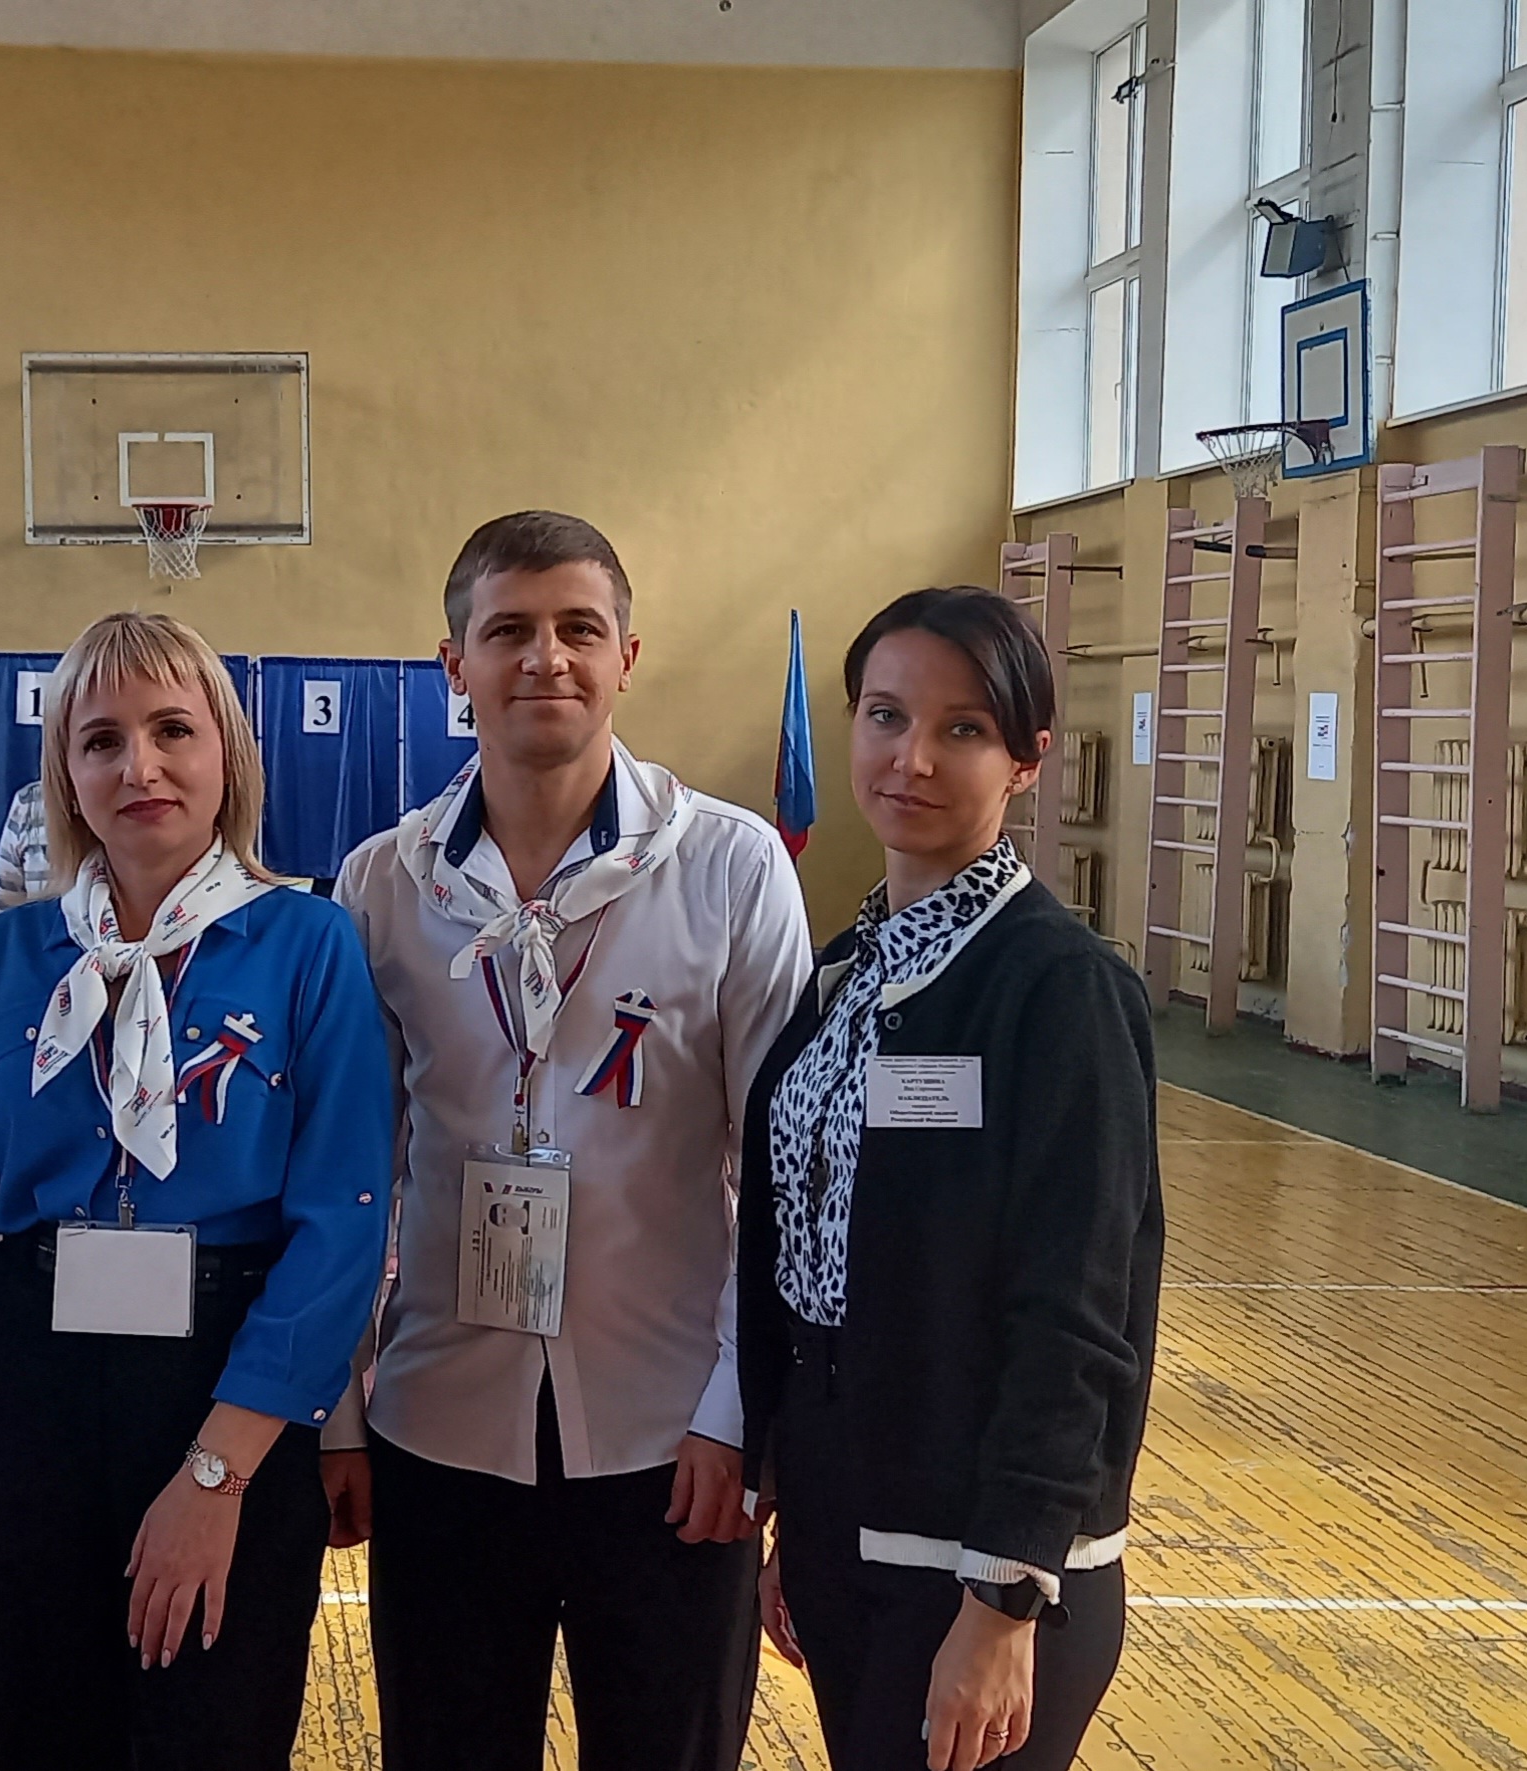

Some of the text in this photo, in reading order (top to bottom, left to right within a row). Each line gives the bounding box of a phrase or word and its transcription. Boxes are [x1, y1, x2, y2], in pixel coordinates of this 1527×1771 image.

[29, 687, 43, 717] 1
[313, 695, 332, 726] 3
[457, 702, 475, 730] 4
